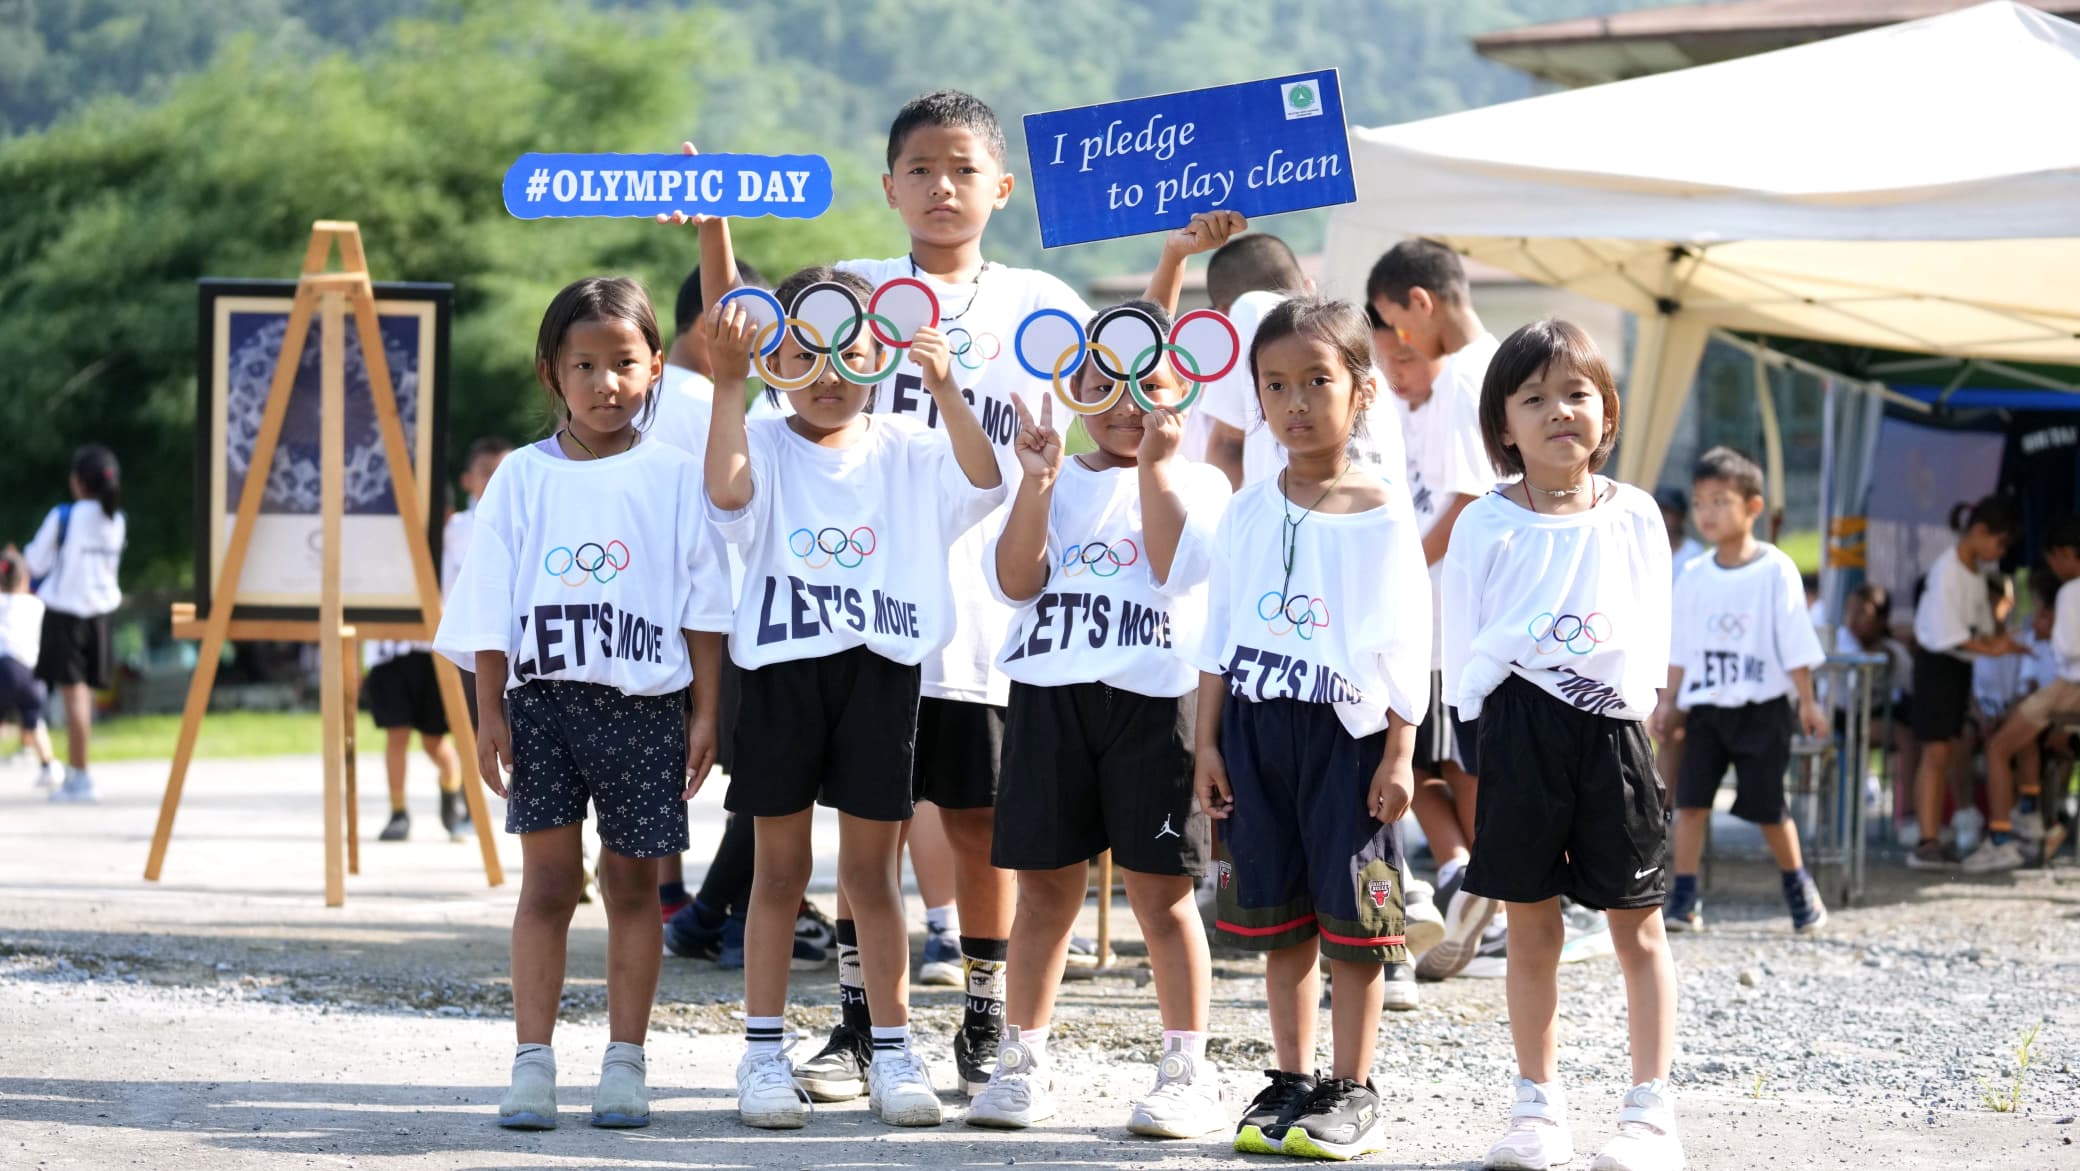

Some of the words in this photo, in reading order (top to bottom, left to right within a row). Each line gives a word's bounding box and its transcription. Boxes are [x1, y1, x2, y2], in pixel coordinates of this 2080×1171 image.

[1049, 132, 1069, 166] I
[1078, 113, 1196, 173] pledge
[525, 168, 724, 203] #OLYMPIC
[737, 170, 811, 203] DAY
[1106, 179, 1144, 210] to
[1153, 161, 1235, 216] play
[1246, 149, 1343, 190] clean
[982, 396, 1023, 446] MOV
[616, 608, 664, 664] MOVE
[757, 575, 867, 647] LET'S
[872, 589, 920, 639] MOVE
[1219, 644, 1308, 702] ET'S
